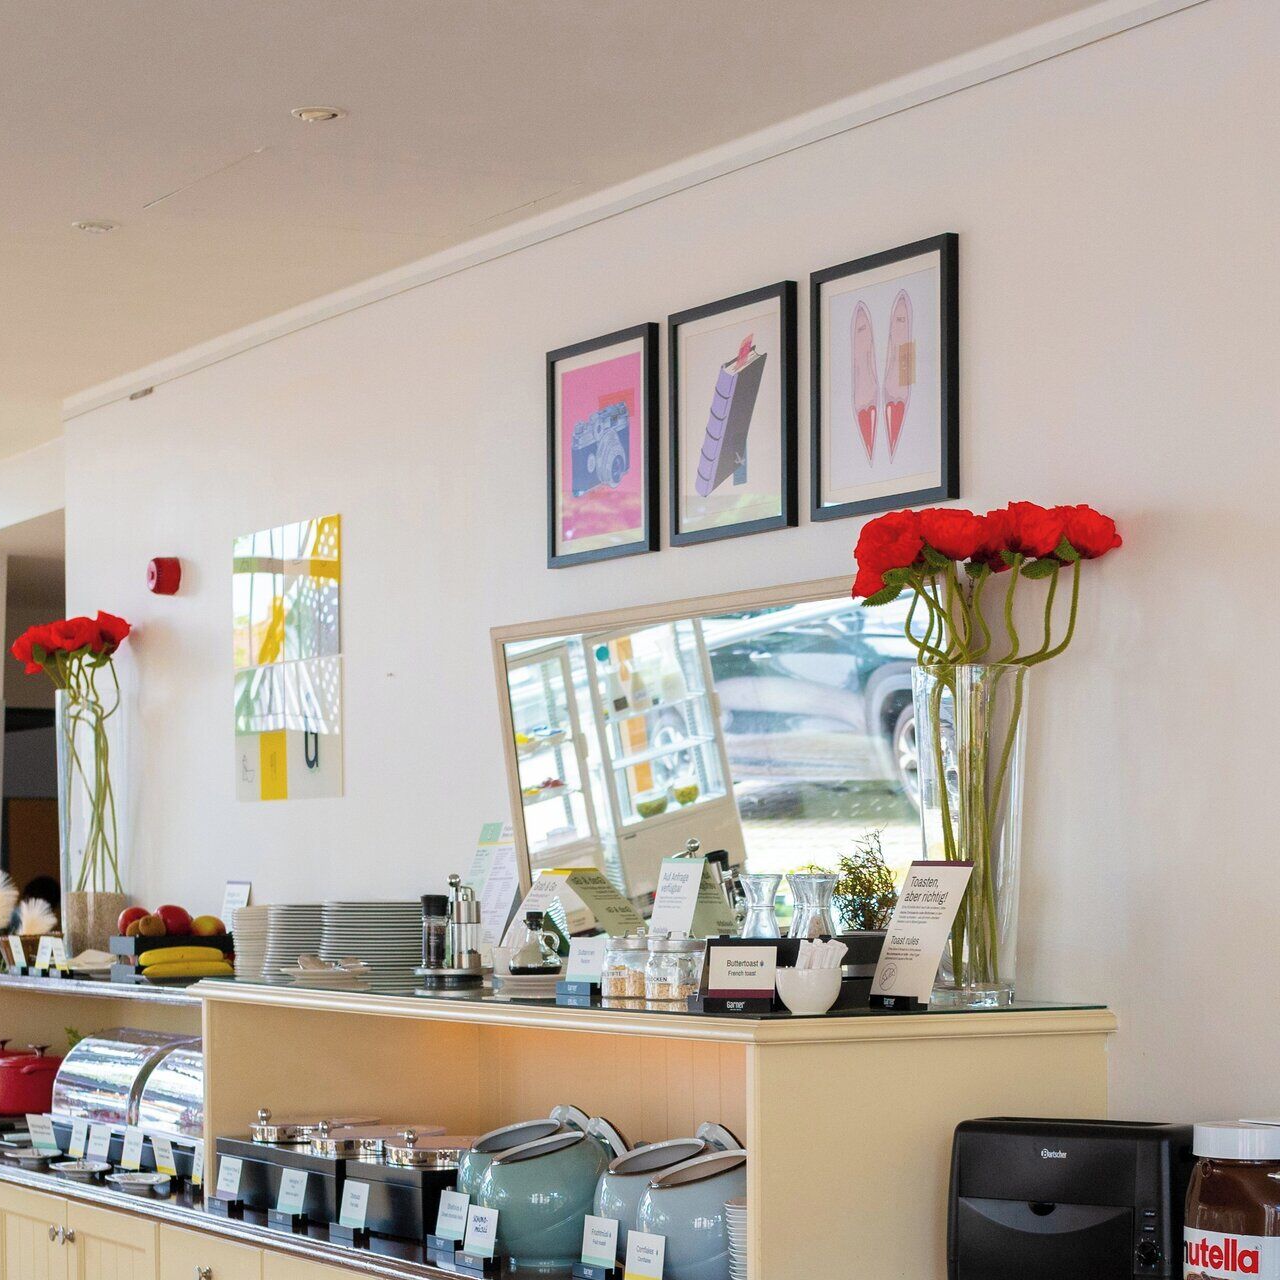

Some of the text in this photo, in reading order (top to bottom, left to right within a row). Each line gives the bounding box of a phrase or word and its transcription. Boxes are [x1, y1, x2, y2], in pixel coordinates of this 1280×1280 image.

[910, 875, 939, 888] Toasten,
[904, 890, 949, 906] aber richtig!
[890, 935, 920, 946] Toast rules
[726, 958, 759, 968] Buttertoast
[727, 969, 743, 977] French
[726, 1000, 745, 1009] Garner
